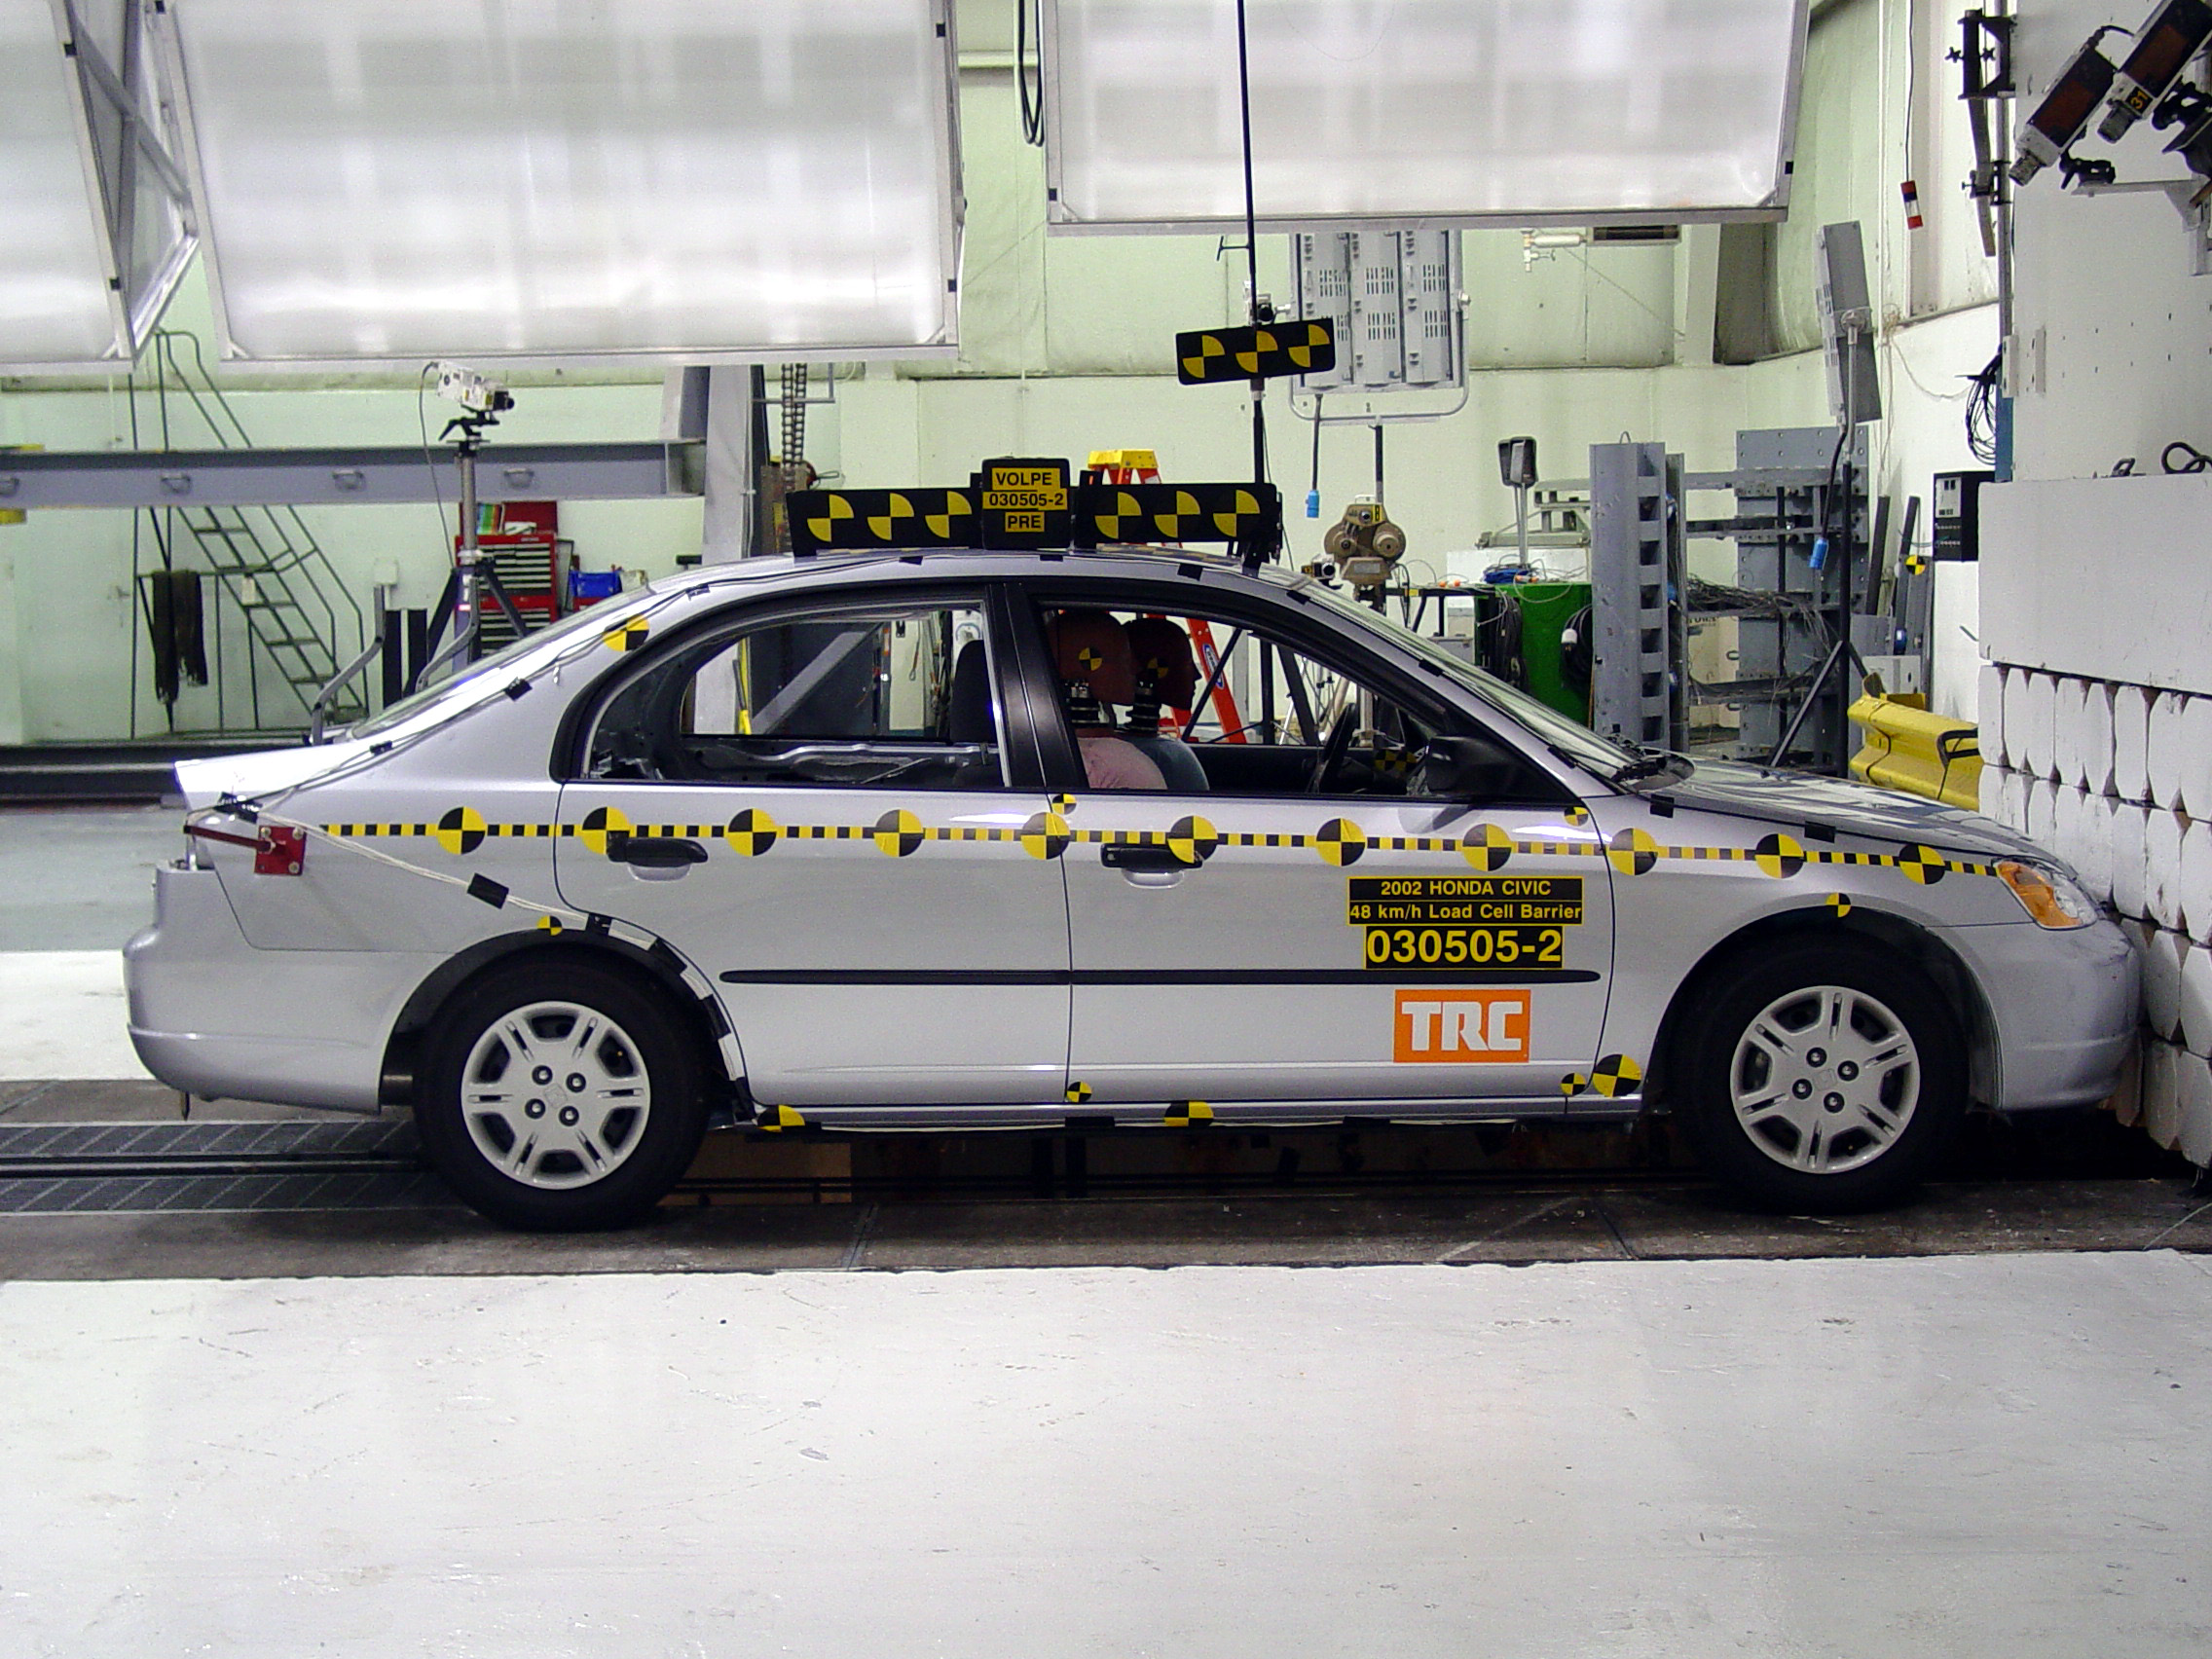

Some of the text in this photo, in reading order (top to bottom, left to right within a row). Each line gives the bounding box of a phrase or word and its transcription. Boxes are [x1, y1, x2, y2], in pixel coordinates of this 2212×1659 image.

[995, 472, 1052, 486] VOLPE
[988, 493, 1064, 506] 030505-2
[1008, 515, 1042, 529] PRE
[1381, 880, 1551, 896] 2002 HONDA CIVIC
[1349, 903, 1582, 920] 48 km/h Load Cell Barrier
[1367, 930, 1562, 963] 030505-2
[1401, 1001, 1524, 1051] TRC
